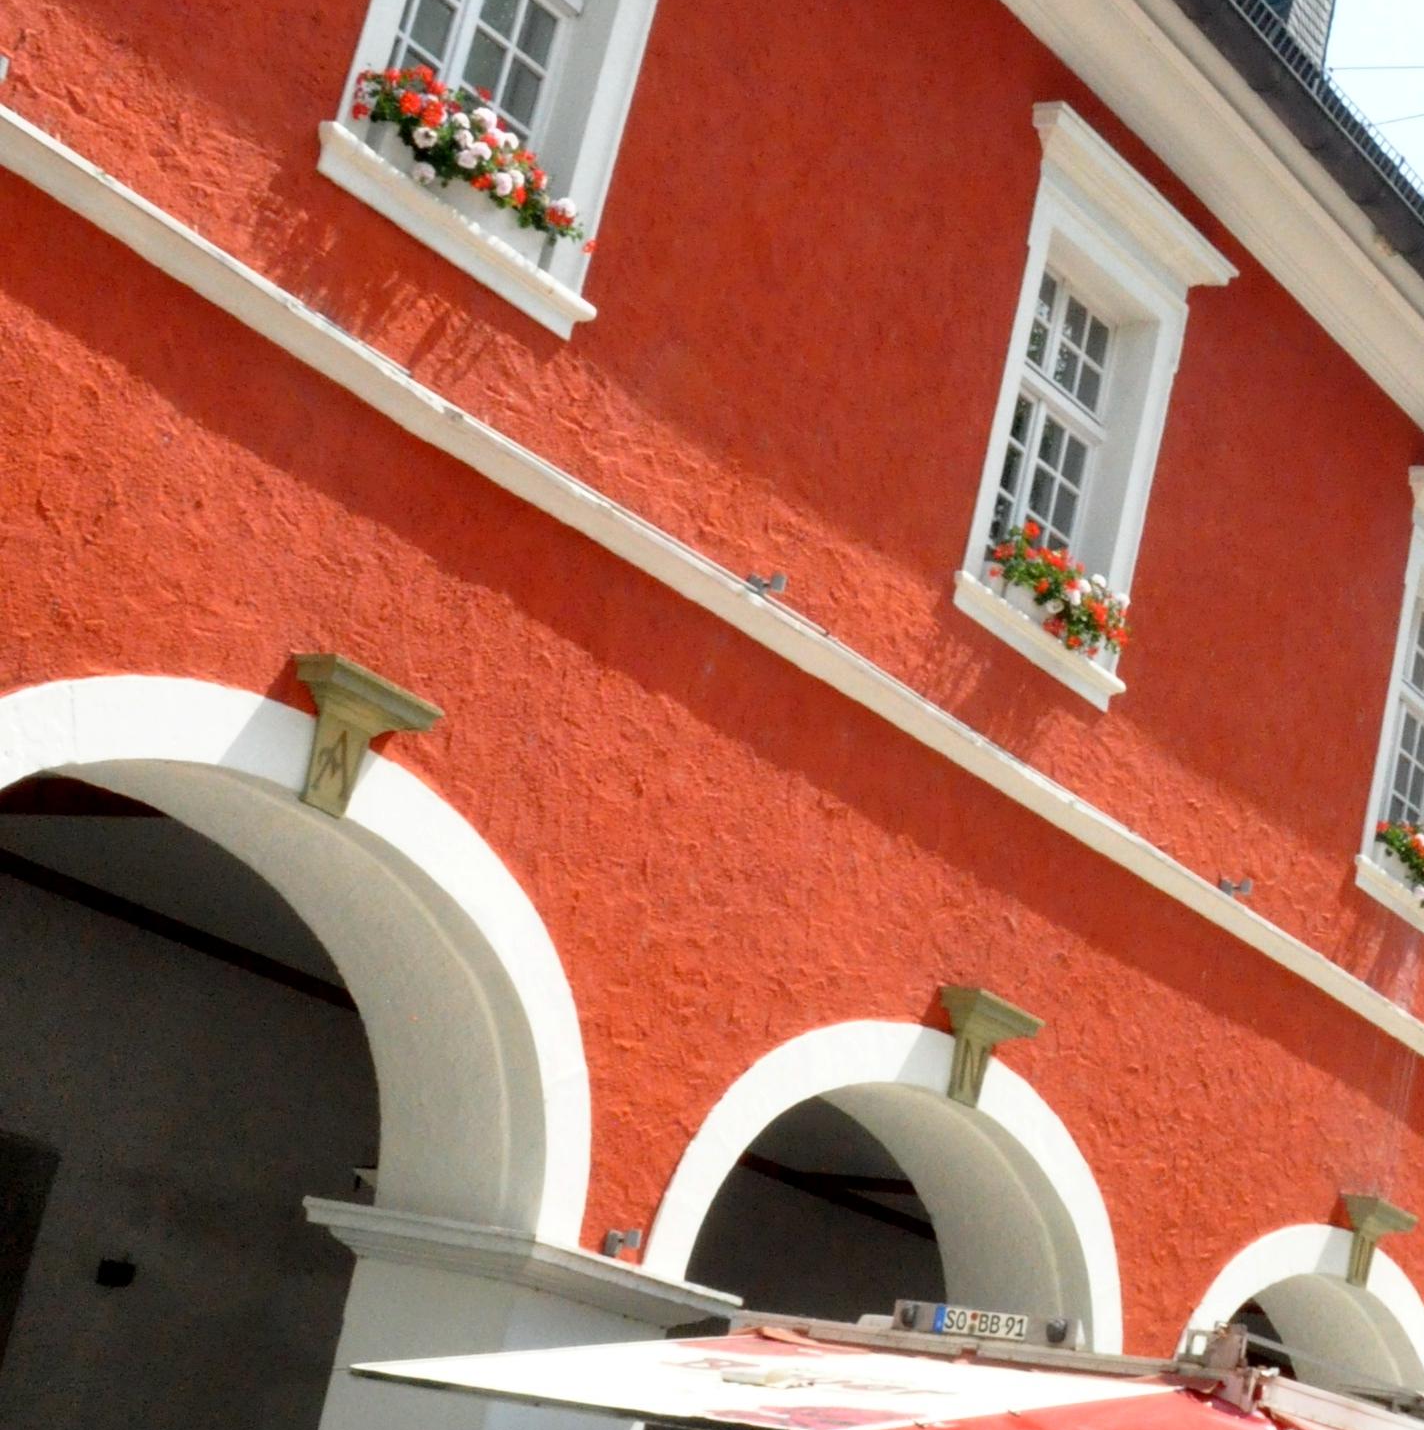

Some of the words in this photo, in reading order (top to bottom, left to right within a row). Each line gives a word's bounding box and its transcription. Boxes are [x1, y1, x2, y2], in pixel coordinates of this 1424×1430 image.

[944, 1309, 967, 1331] SO
[978, 1313, 1001, 1334] BB
[1005, 1316, 1025, 1338] 91
